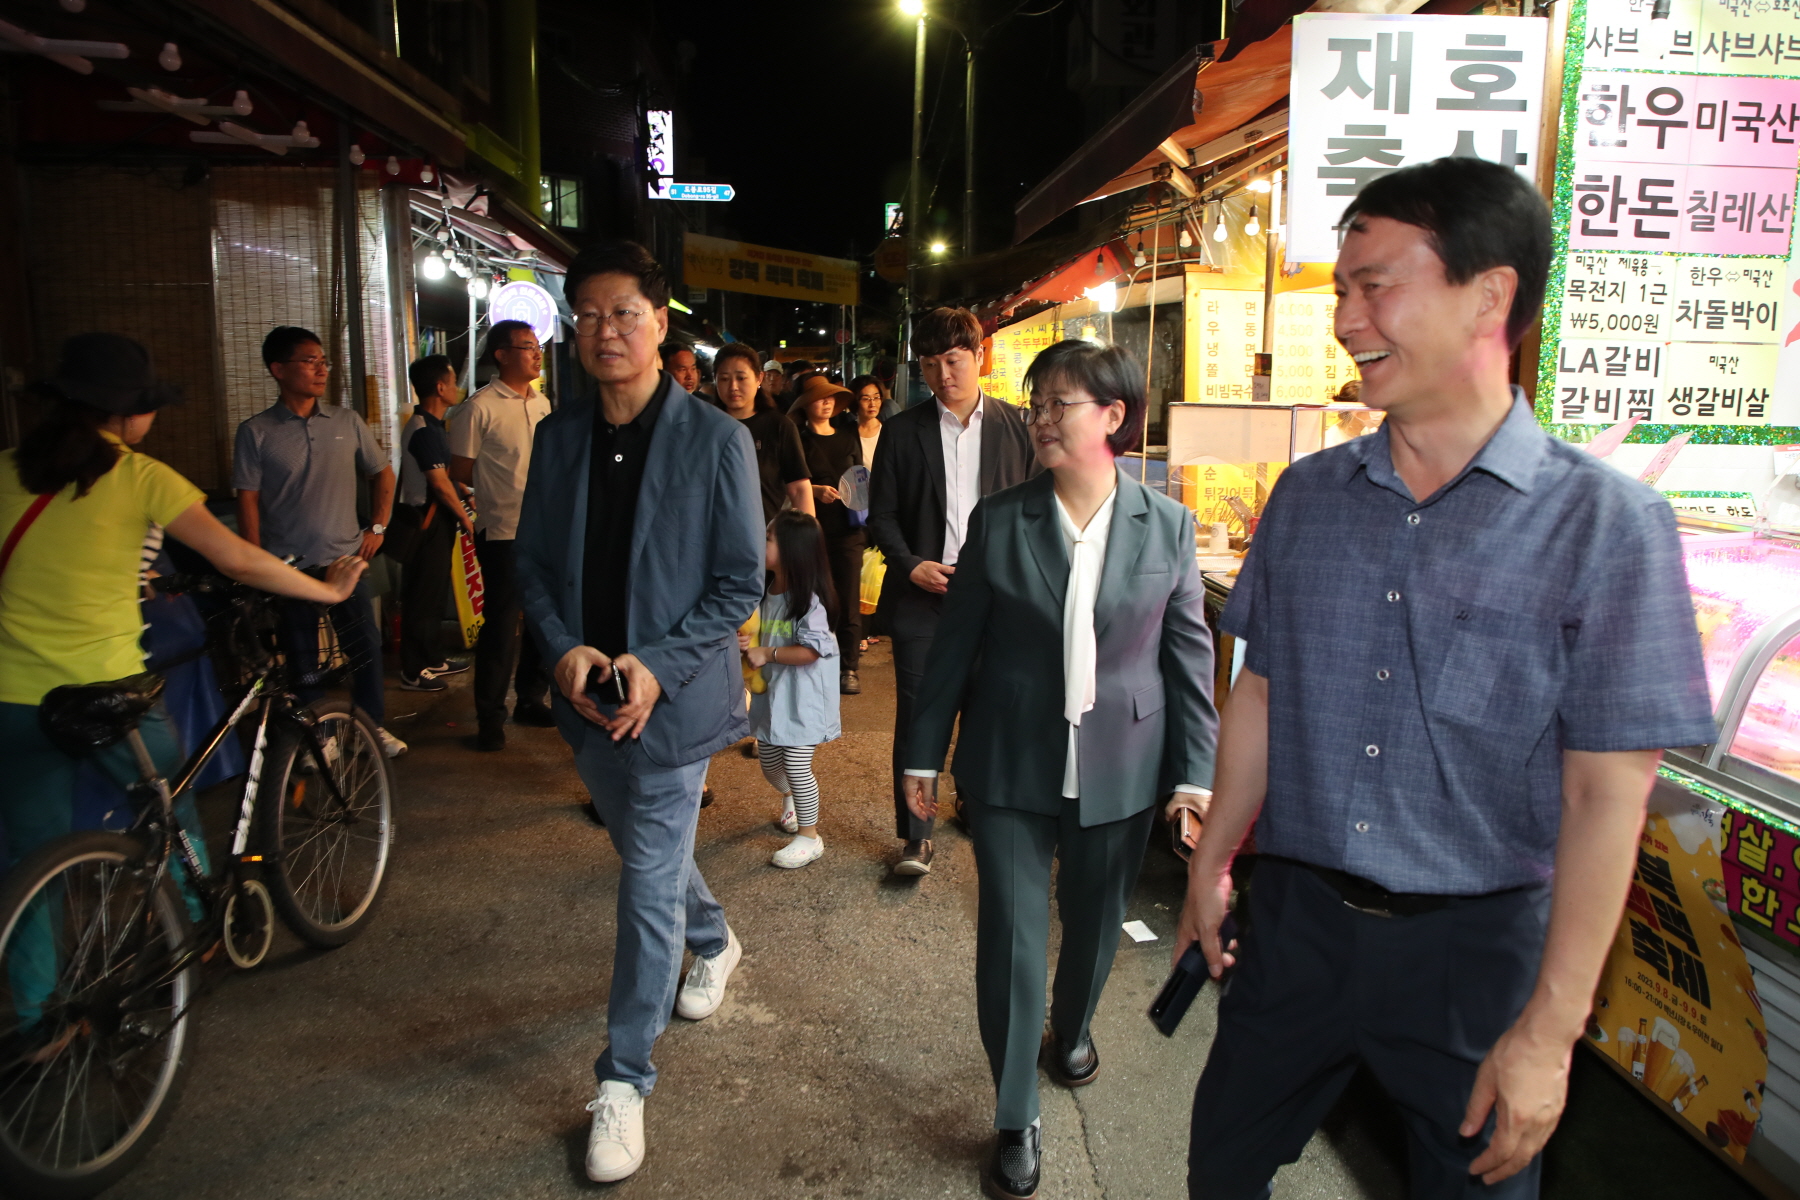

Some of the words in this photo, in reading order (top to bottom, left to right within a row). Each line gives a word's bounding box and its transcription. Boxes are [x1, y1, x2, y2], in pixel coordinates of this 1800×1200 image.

[1586, 26, 1694, 60] 샤브브
[1582, 84, 1689, 150] 한우
[1696, 100, 1800, 144] 미국산
[1575, 174, 1679, 239] 한돈
[1686, 190, 1791, 233] 칠레산
[1575, 256, 1608, 275] 미국산
[1618, 257, 1649, 277] 제육용
[1690, 267, 1723, 287] 한우
[1743, 269, 1773, 288] 미국산
[1567, 279, 1626, 304] 목전지
[1640, 283, 1668, 305] 1근
[1675, 299, 1778, 332] 차돌박이
[1559, 346, 1661, 378] LA갈비
[1709, 356, 1739, 375] 미국산
[1561, 386, 1655, 422] 갈비찜
[1667, 387, 1770, 418] 생갈비살
